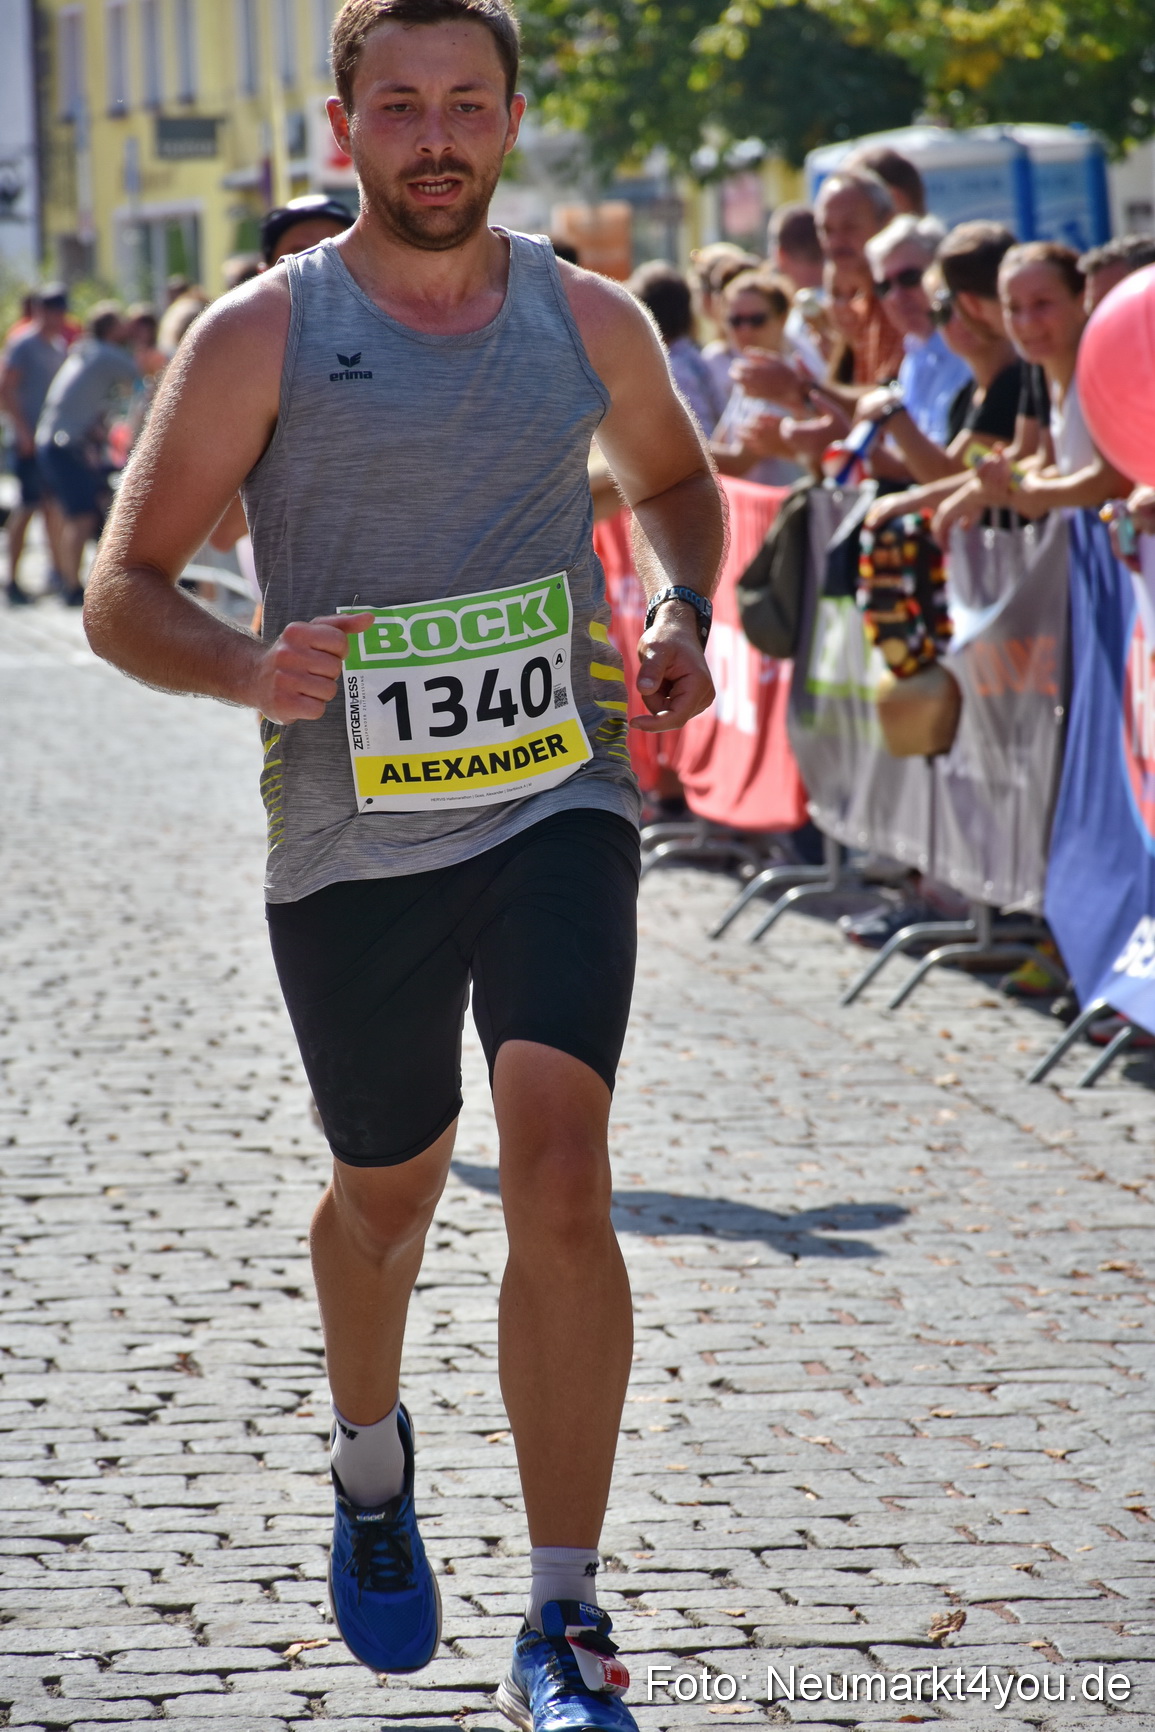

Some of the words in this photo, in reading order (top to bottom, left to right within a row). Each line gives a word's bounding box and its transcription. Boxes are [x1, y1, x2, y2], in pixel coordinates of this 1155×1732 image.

[330, 370, 373, 382] erima
[359, 588, 557, 661] BOCK
[555, 653, 563, 665] A
[377, 656, 552, 741] 1340
[380, 733, 568, 784] ALEXANDER
